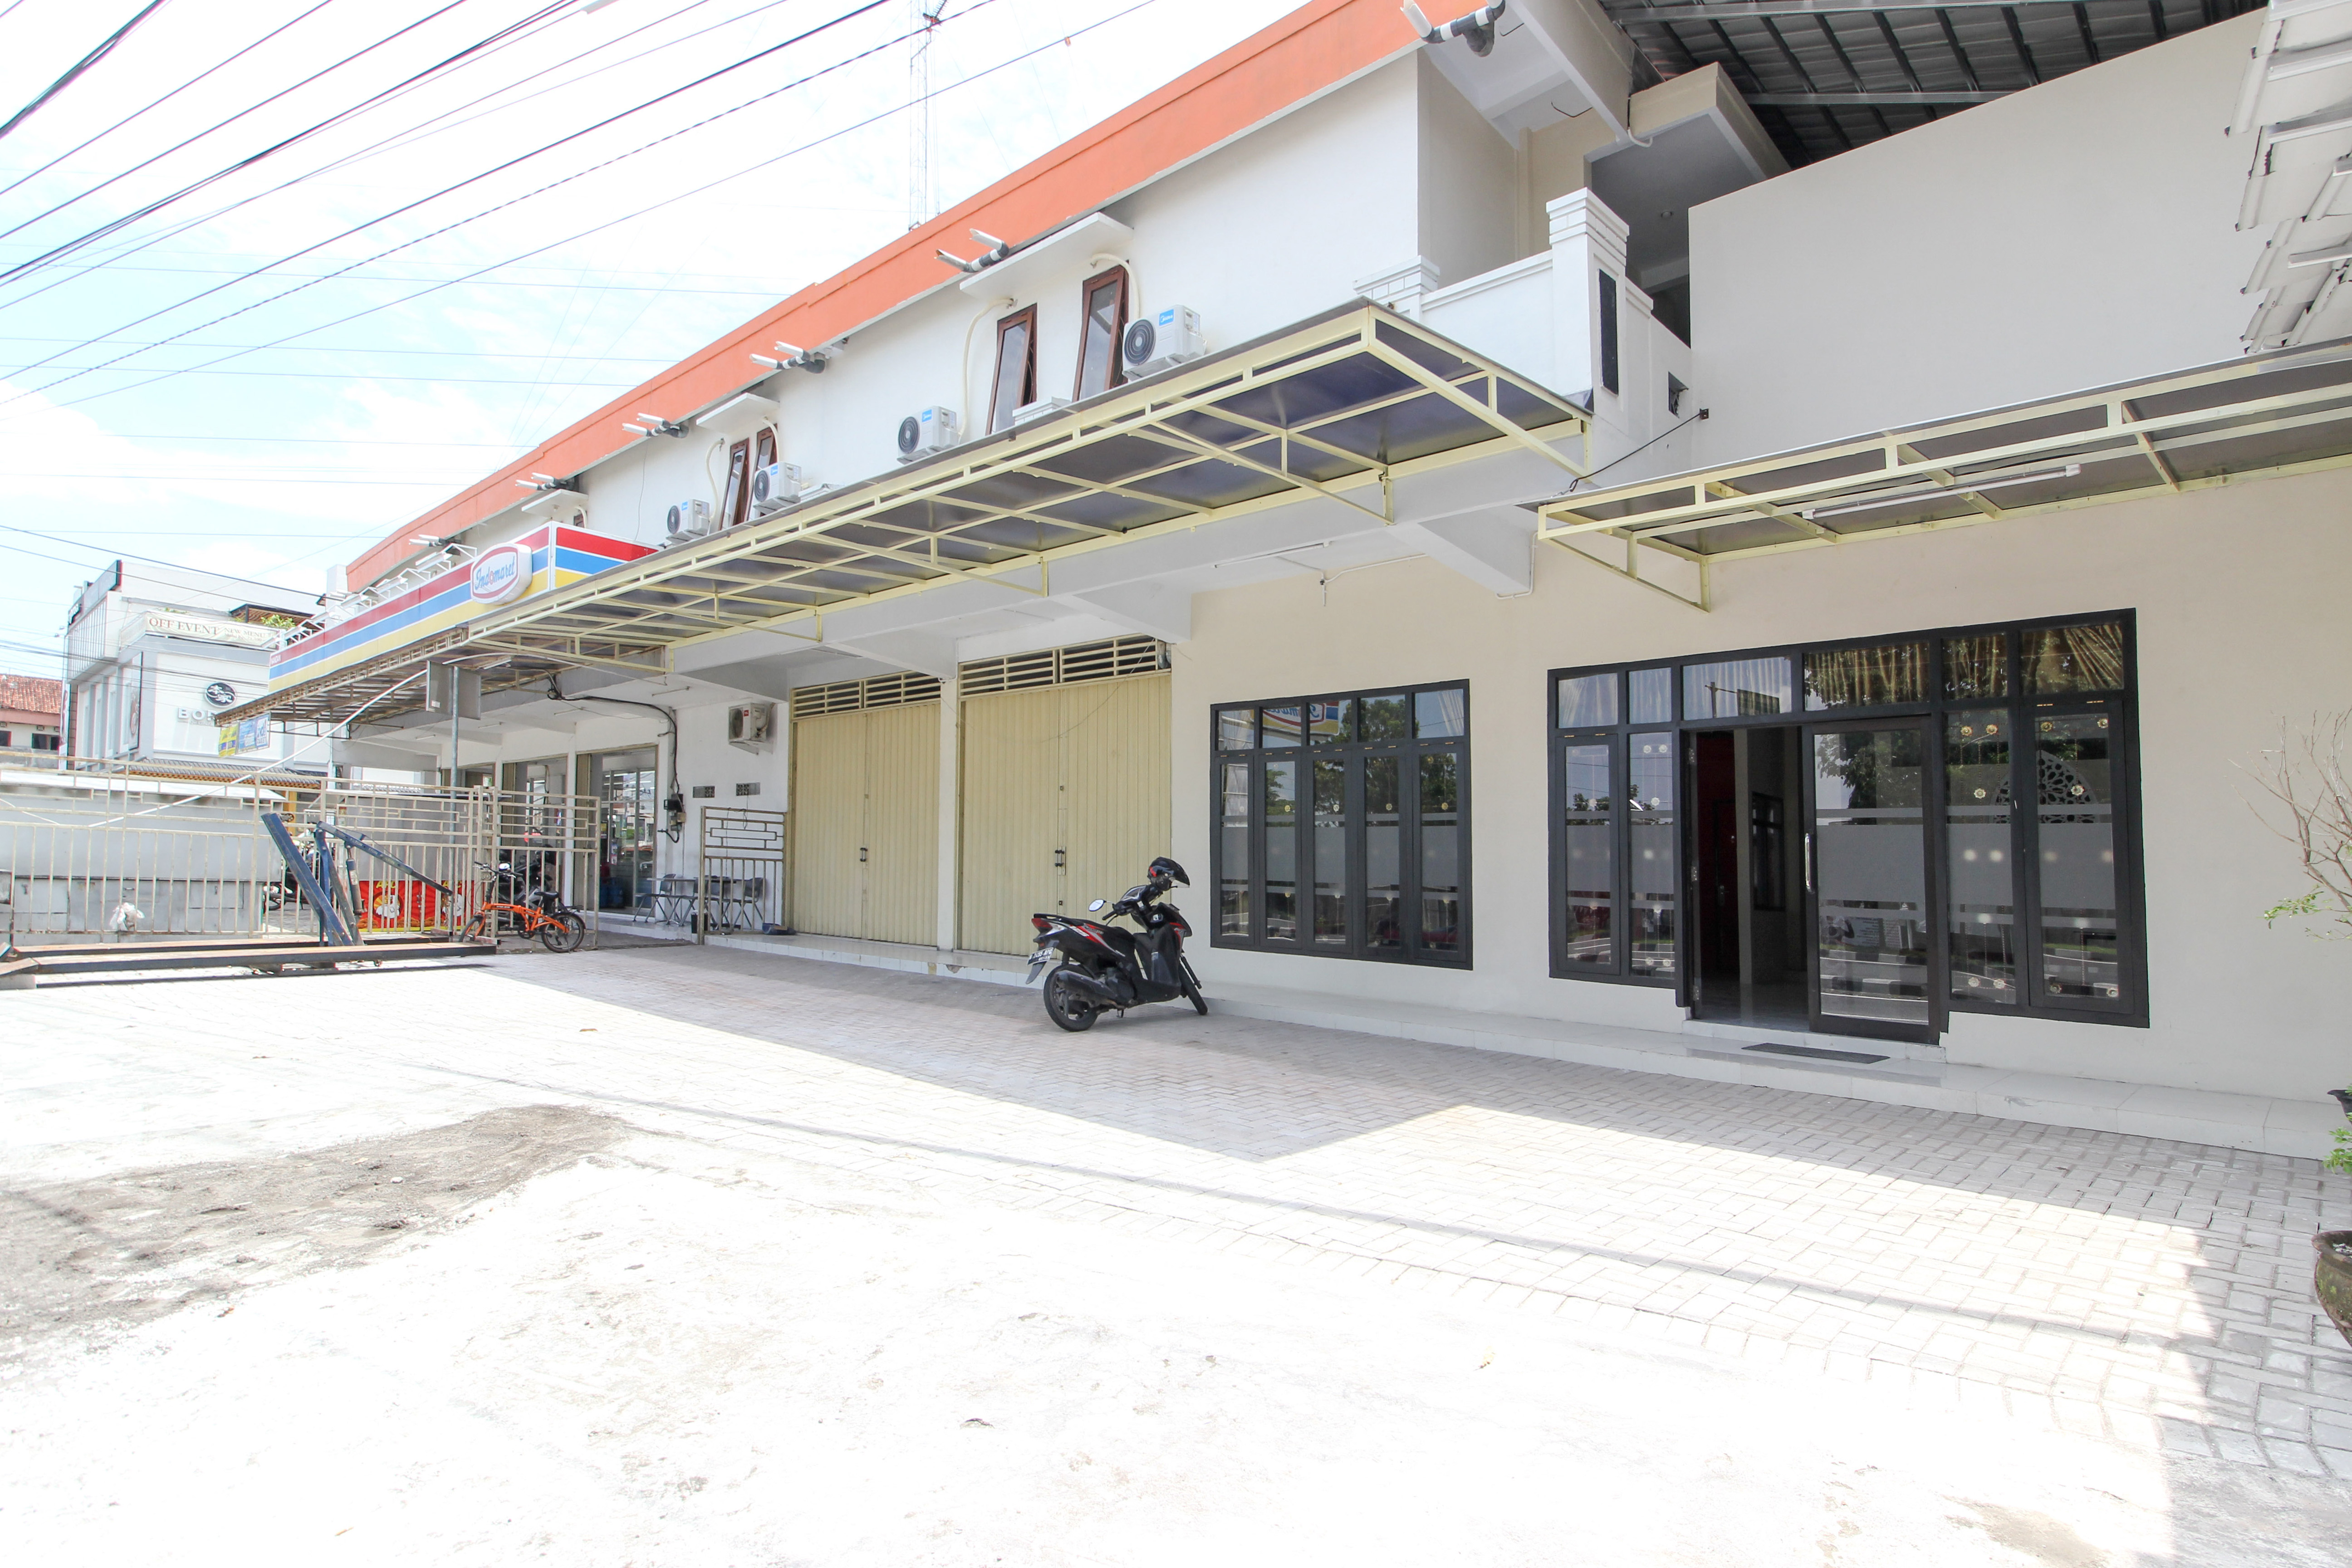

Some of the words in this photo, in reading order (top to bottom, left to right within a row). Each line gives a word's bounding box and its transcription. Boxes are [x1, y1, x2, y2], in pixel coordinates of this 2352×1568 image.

[475, 555, 515, 591] Indomaret
[149, 617, 175, 630] OFF
[178, 621, 218, 635] EVENT
